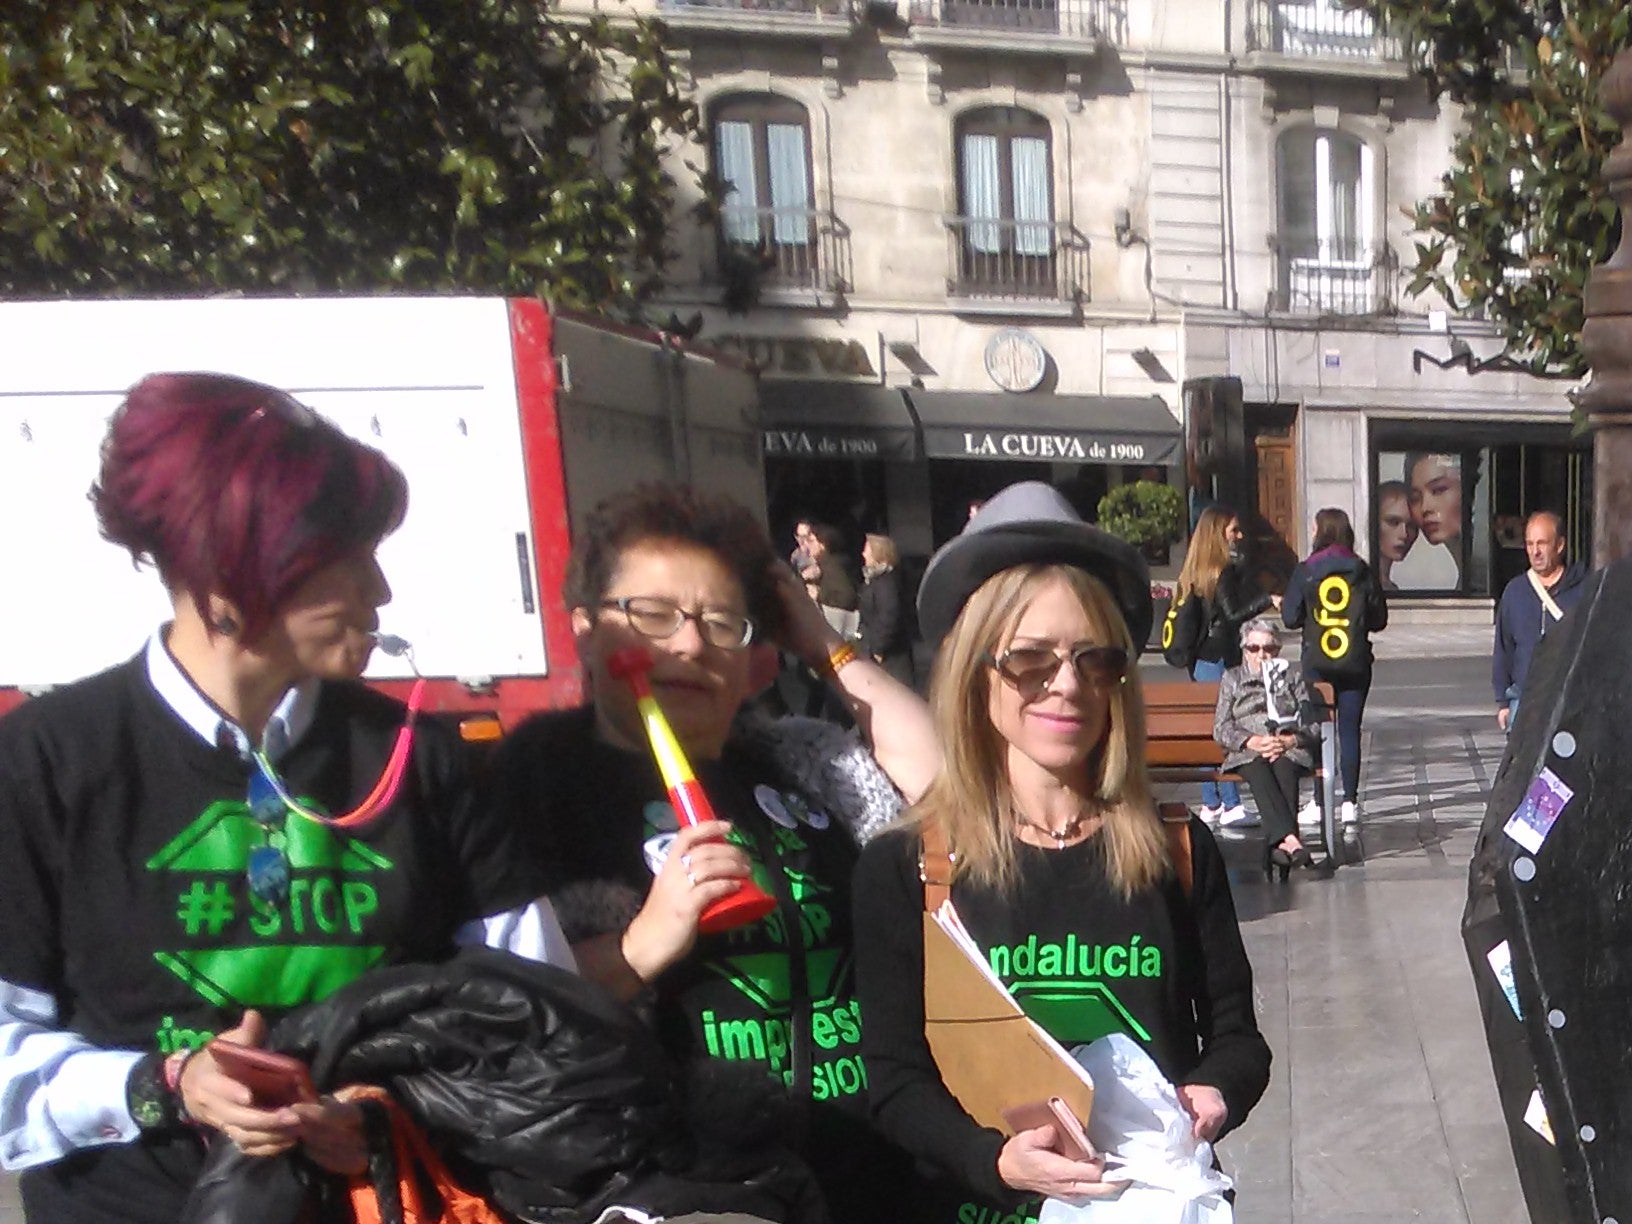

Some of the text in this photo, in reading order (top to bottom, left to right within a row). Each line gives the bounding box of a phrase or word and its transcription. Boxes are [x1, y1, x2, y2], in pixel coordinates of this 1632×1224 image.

[764, 430, 812, 451] EVA
[963, 433, 1144, 460] LA CUEVA de 1900
[1313, 575, 1351, 659] ofo
[989, 933, 1163, 978] ndalucía
